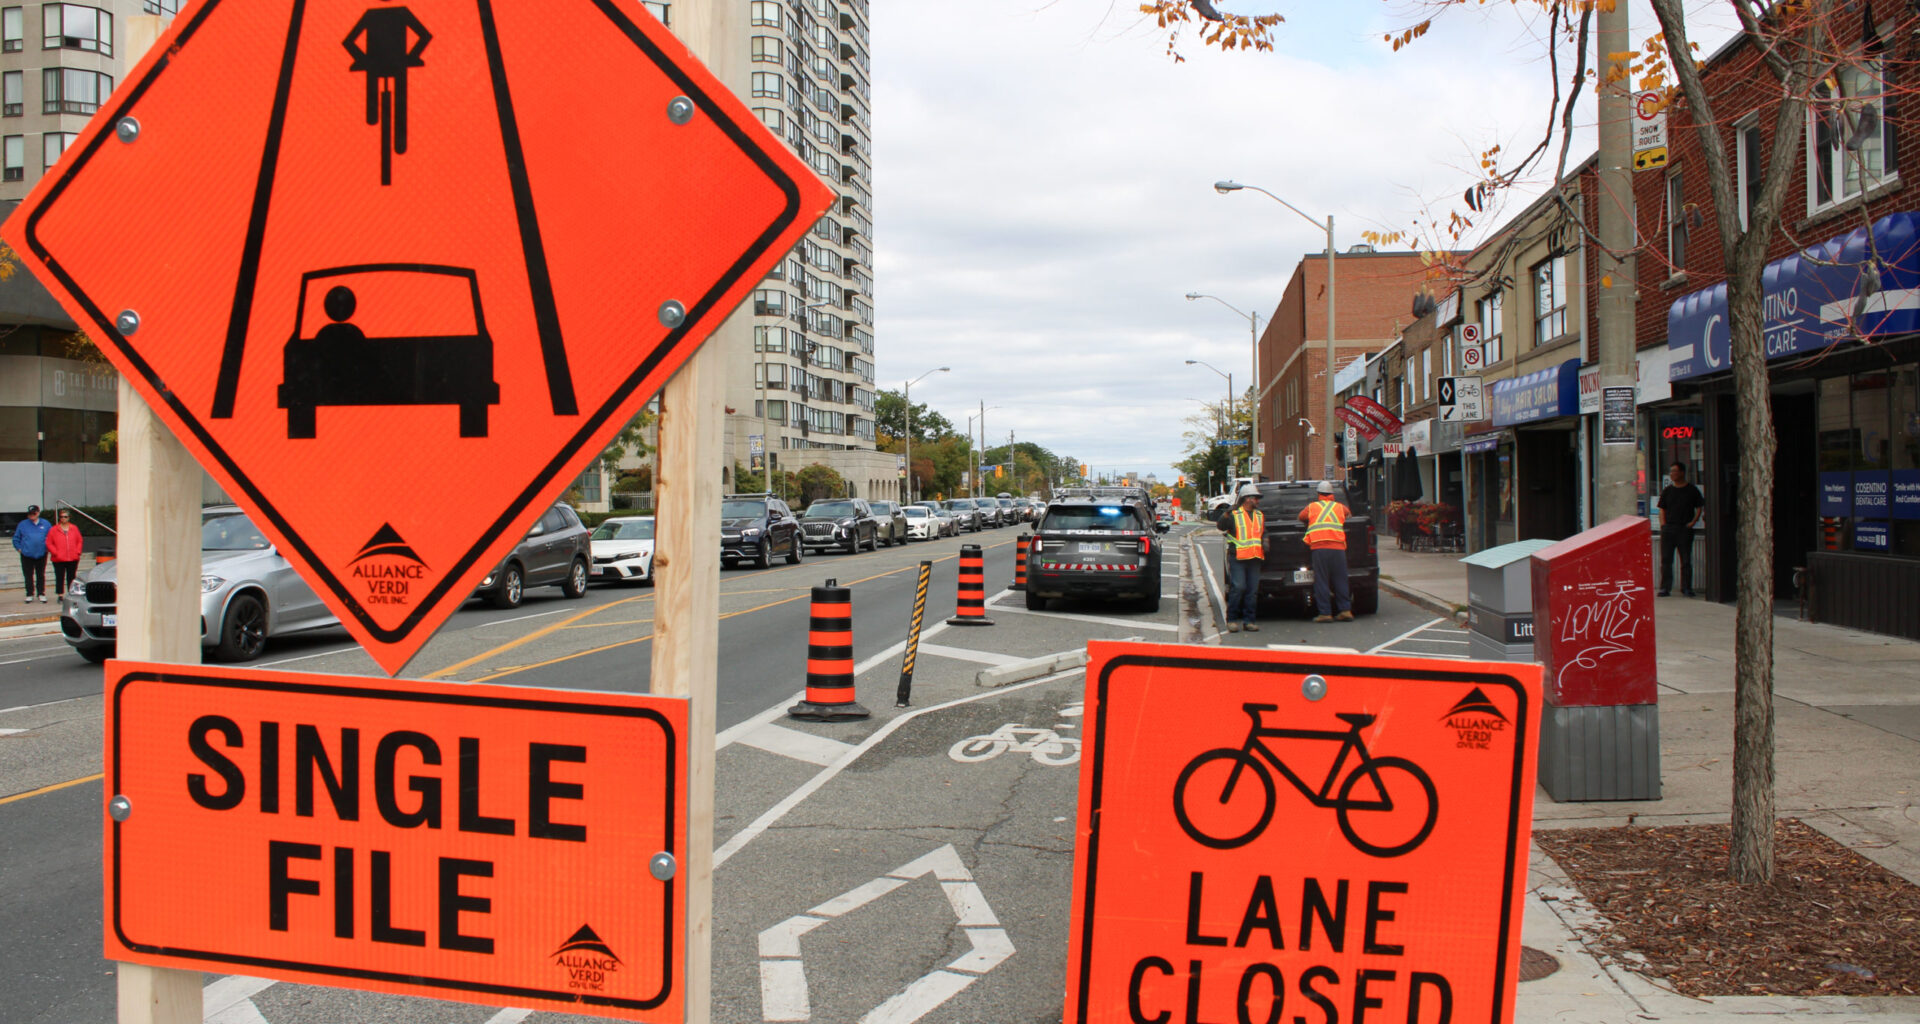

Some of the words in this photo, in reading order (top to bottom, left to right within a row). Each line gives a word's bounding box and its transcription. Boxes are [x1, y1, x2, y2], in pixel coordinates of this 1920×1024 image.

[1640, 125, 1659, 136] SNOW
[1639, 134, 1661, 146] ROUTE
[1767, 328, 1797, 355] CARE
[1534, 382, 1559, 406] SALON
[1461, 411, 1478, 419] LANE
[1347, 414, 1370, 433] Lunch
[1662, 426, 1693, 439] OPEN
[1383, 444, 1401, 454] NAIL
[1855, 482, 1887, 493] COSENTINO
[1855, 497, 1873, 506] DENTAL
[1874, 496, 1887, 506] CARE
[352, 564, 424, 579] ALLIANCE
[367, 580, 409, 595] VERDI
[367, 595, 388, 604] CIVIL
[1513, 622, 1535, 637] Litt
[1445, 718, 1505, 731] ALLIANCE
[1457, 730, 1492, 743] VERDI
[187, 714, 587, 843] SINGLE
[269, 839, 495, 955] FILE
[1185, 871, 1409, 957] LANE
[556, 955, 618, 972] ALLIANCE
[569, 968, 605, 983] VERDI
[1128, 955, 1453, 1024] CLOSED
